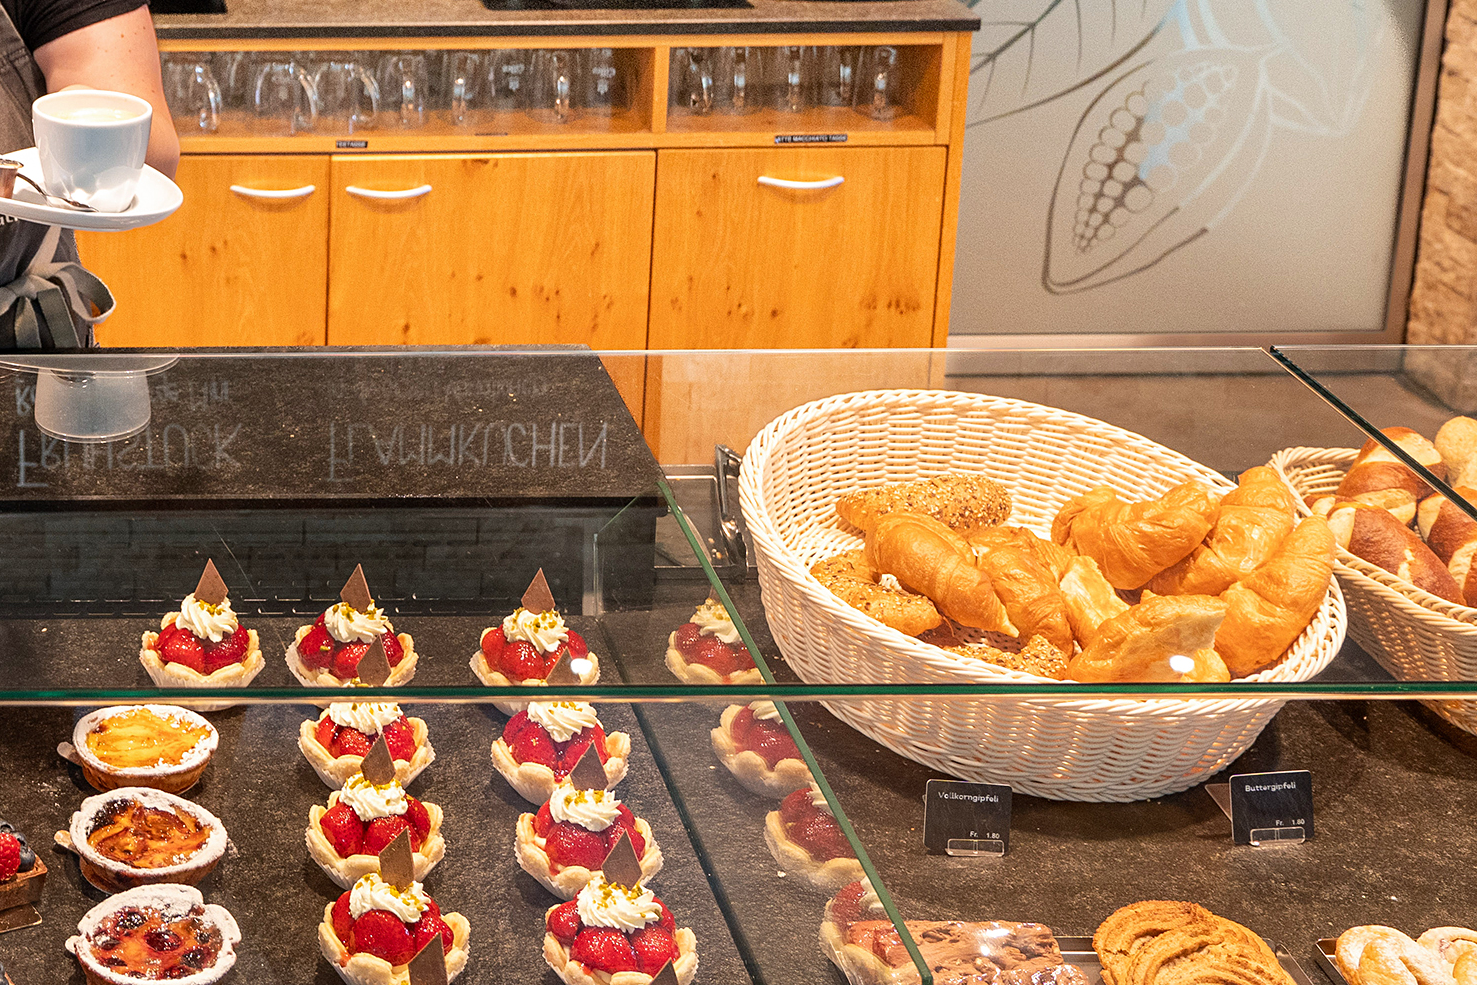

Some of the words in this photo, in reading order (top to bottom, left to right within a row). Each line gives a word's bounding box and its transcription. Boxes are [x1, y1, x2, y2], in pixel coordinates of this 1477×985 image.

[1244, 782, 1297, 793] Buttergipfeli
[937, 791, 999, 803] Vollkorngipfeli
[1275, 819, 1285, 827] Fr.
[1291, 818, 1306, 826] 1.80
[969, 830, 979, 838] Fr.
